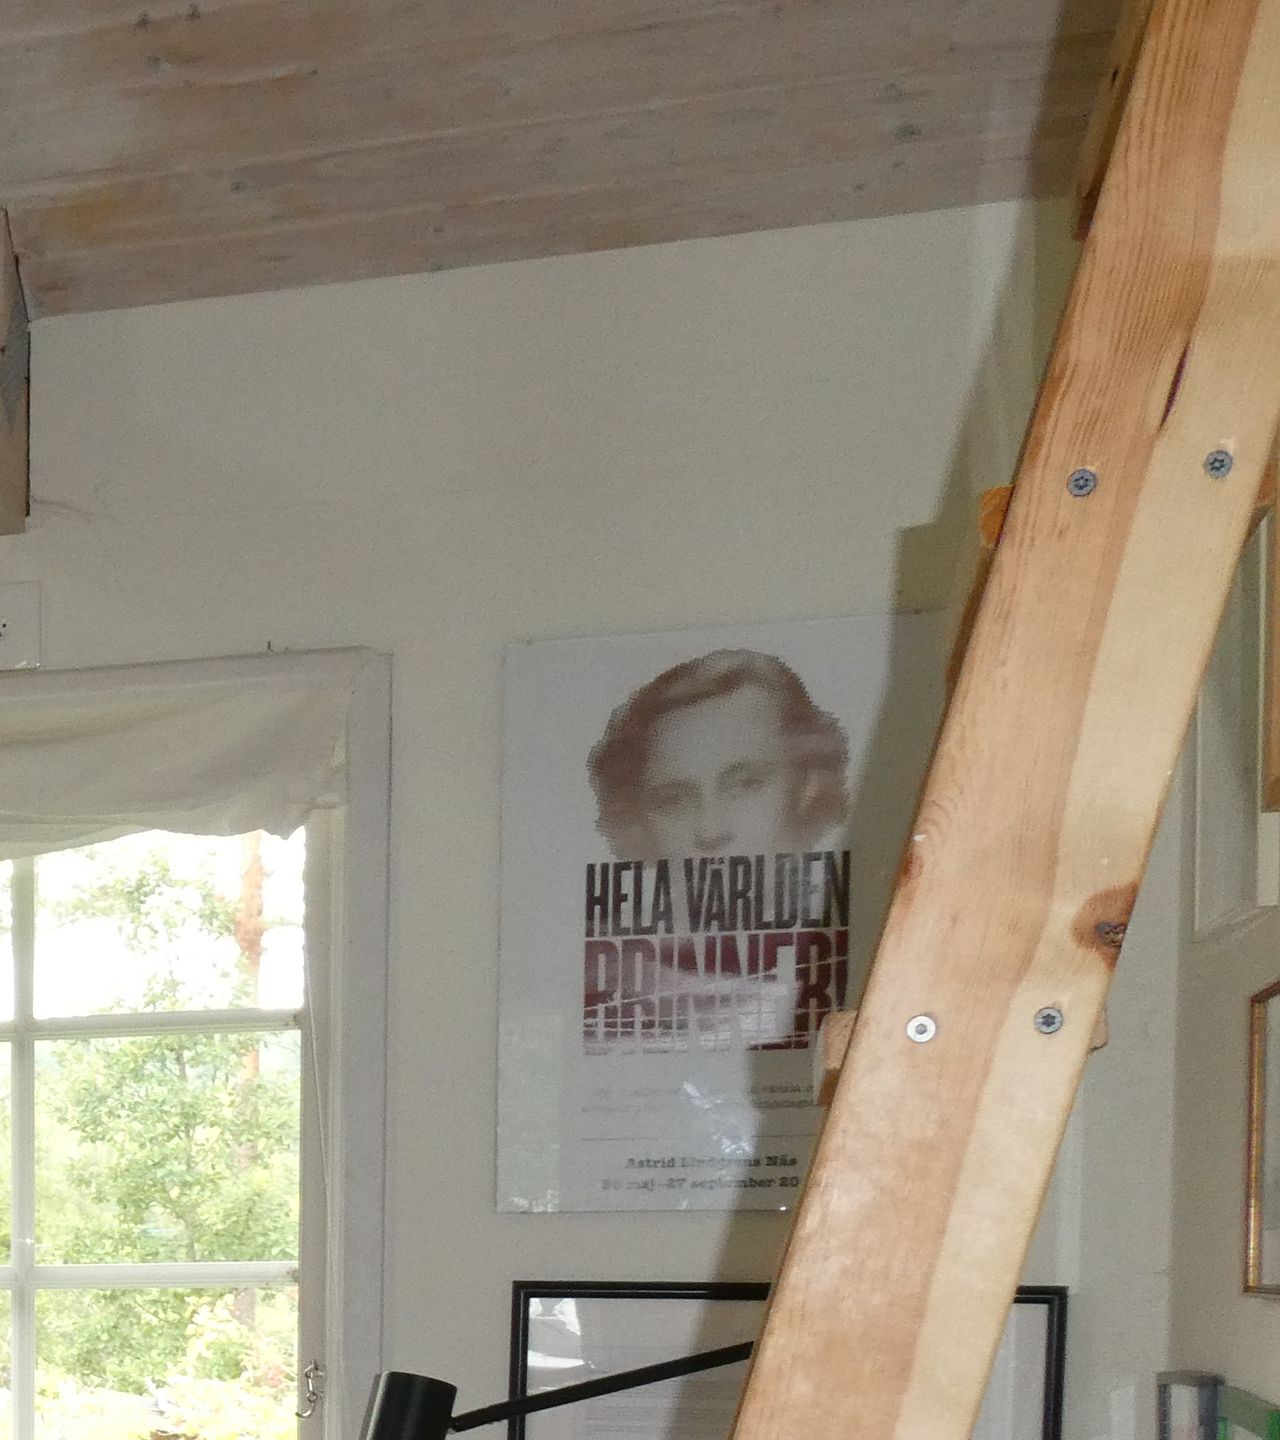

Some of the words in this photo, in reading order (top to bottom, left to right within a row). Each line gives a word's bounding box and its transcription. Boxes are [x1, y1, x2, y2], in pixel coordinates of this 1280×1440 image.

[584, 860, 675, 938] HELA
[683, 850, 851, 936] VÄRLDEN
[583, 930, 849, 1054] BRINNER!
[765, 1155, 798, 1168] Näs
